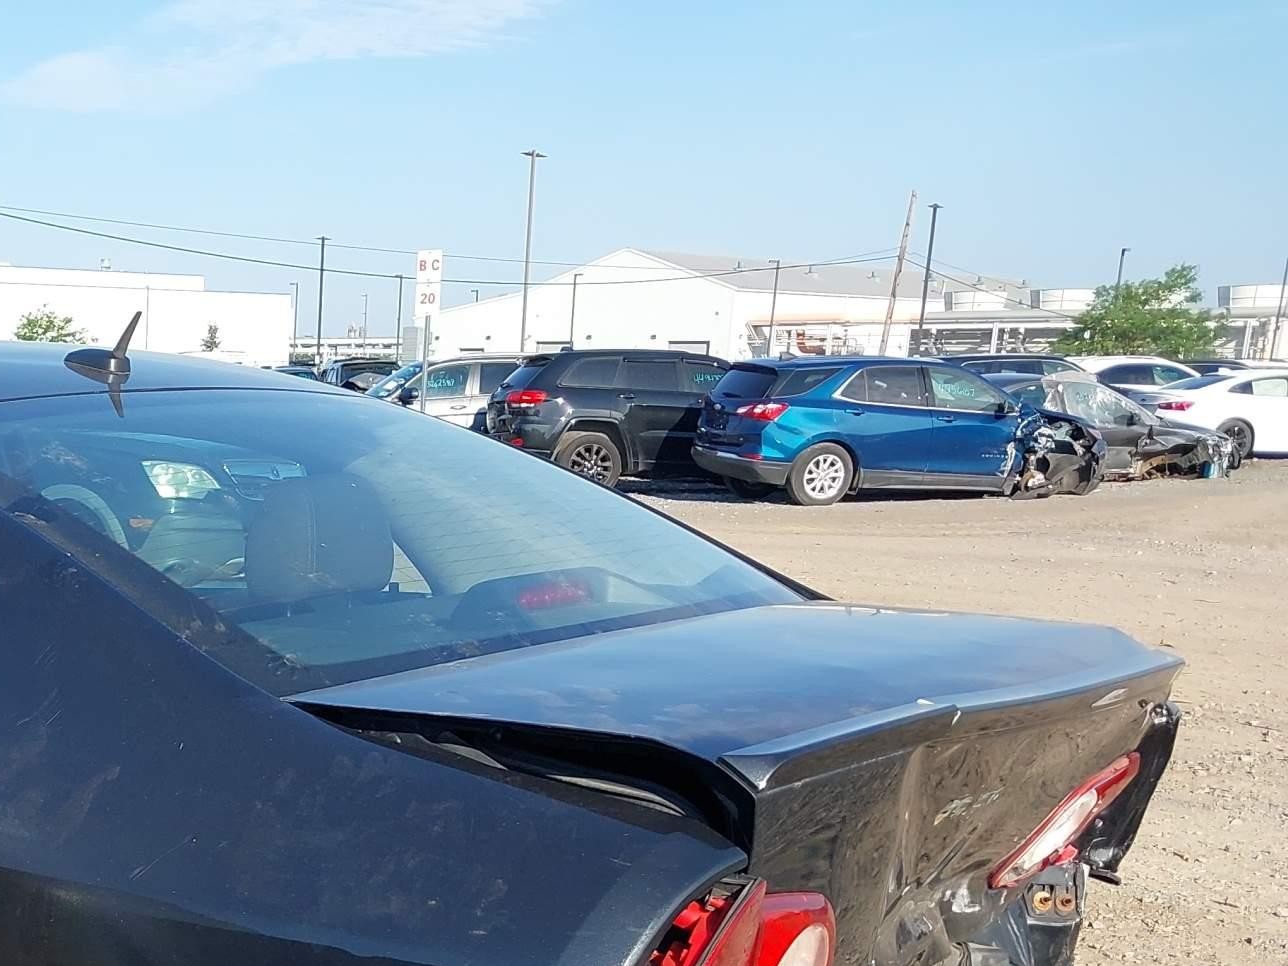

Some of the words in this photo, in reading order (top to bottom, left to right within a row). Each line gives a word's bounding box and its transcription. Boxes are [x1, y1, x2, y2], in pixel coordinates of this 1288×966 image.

[419, 260, 427, 271] B
[431, 259, 440, 270] C
[420, 292, 436, 304] 20
